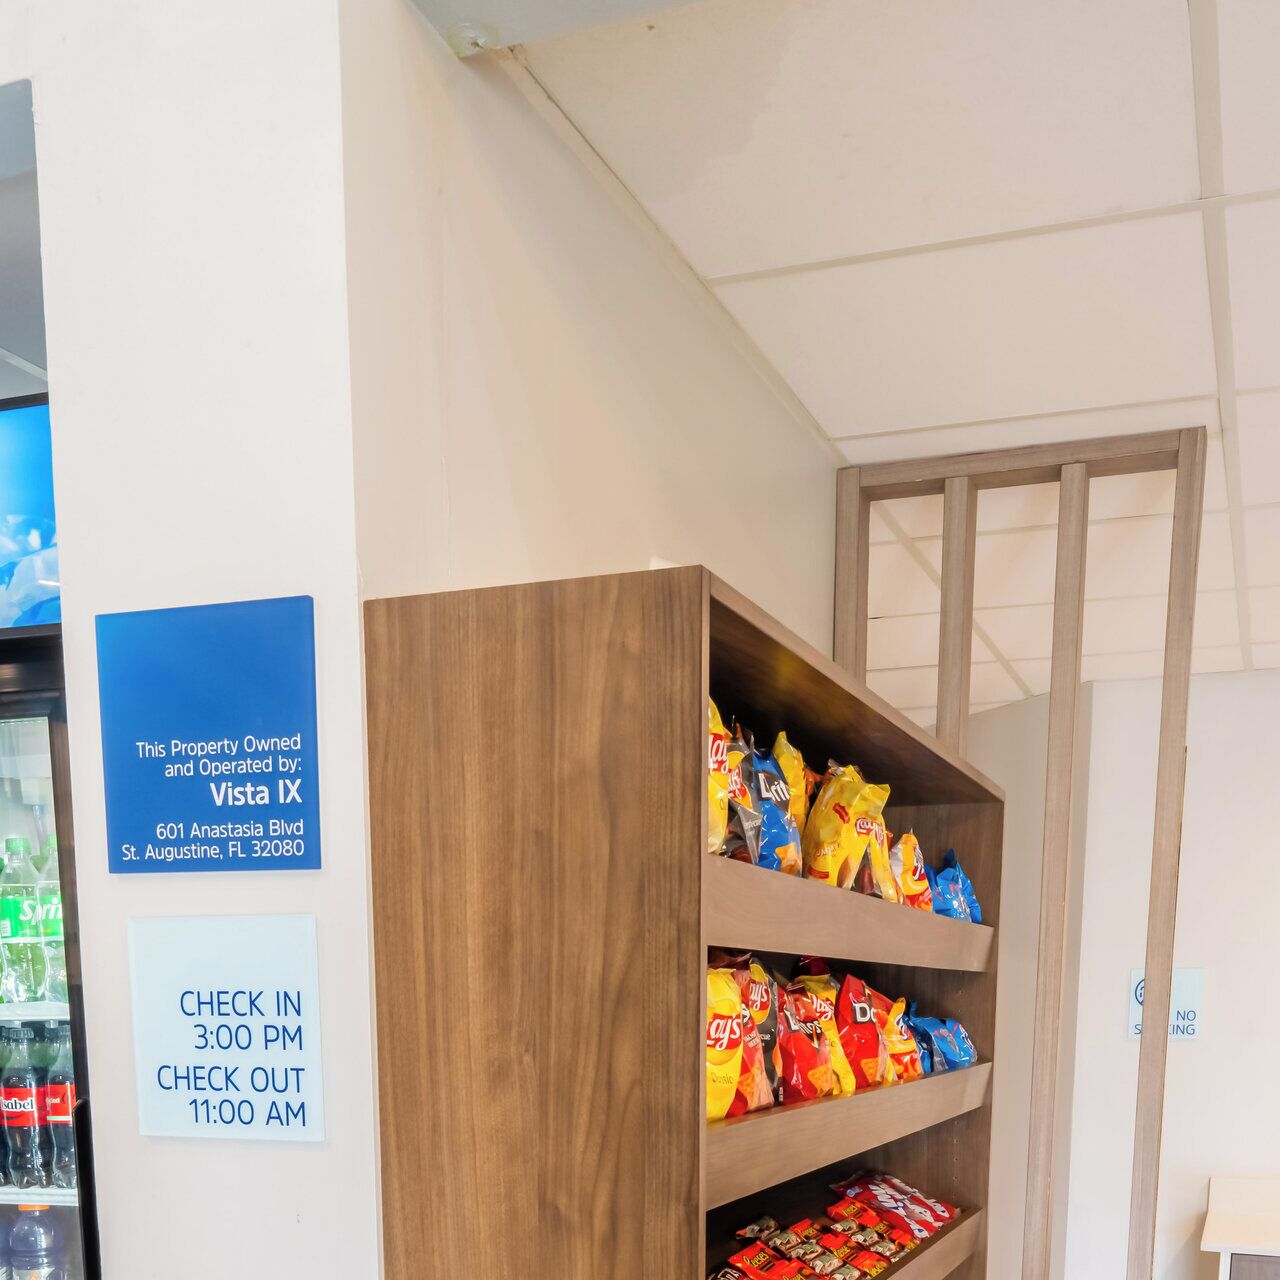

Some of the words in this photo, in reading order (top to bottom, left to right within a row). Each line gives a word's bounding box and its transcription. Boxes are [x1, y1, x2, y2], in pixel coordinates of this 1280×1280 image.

[136, 741, 166, 758] This
[171, 737, 239, 758] Property
[244, 733, 302, 752] Owned
[165, 760, 194, 778] and
[199, 756, 273, 777] Operated
[278, 755, 302, 774] by:
[209, 782, 270, 807] Vista
[278, 778, 303, 804] IX
[156, 823, 184, 840] 601
[190, 821, 263, 839] Anastasia
[269, 818, 304, 836] Blvd
[122, 844, 140, 861] St.
[145, 842, 223, 862] Augustine,
[228, 841, 246, 858] FL
[251, 839, 305, 858] 32080
[180, 990, 265, 1017] CHECK
[276, 990, 302, 1017] IN
[1176, 1010, 1197, 1021] NO
[193, 1024, 252, 1050] 3:00
[263, 1024, 303, 1051] PM
[157, 1065, 240, 1092] CHECK
[250, 1066, 306, 1093] OUT
[189, 1099, 255, 1125] 11:00
[265, 1100, 306, 1127] AM
